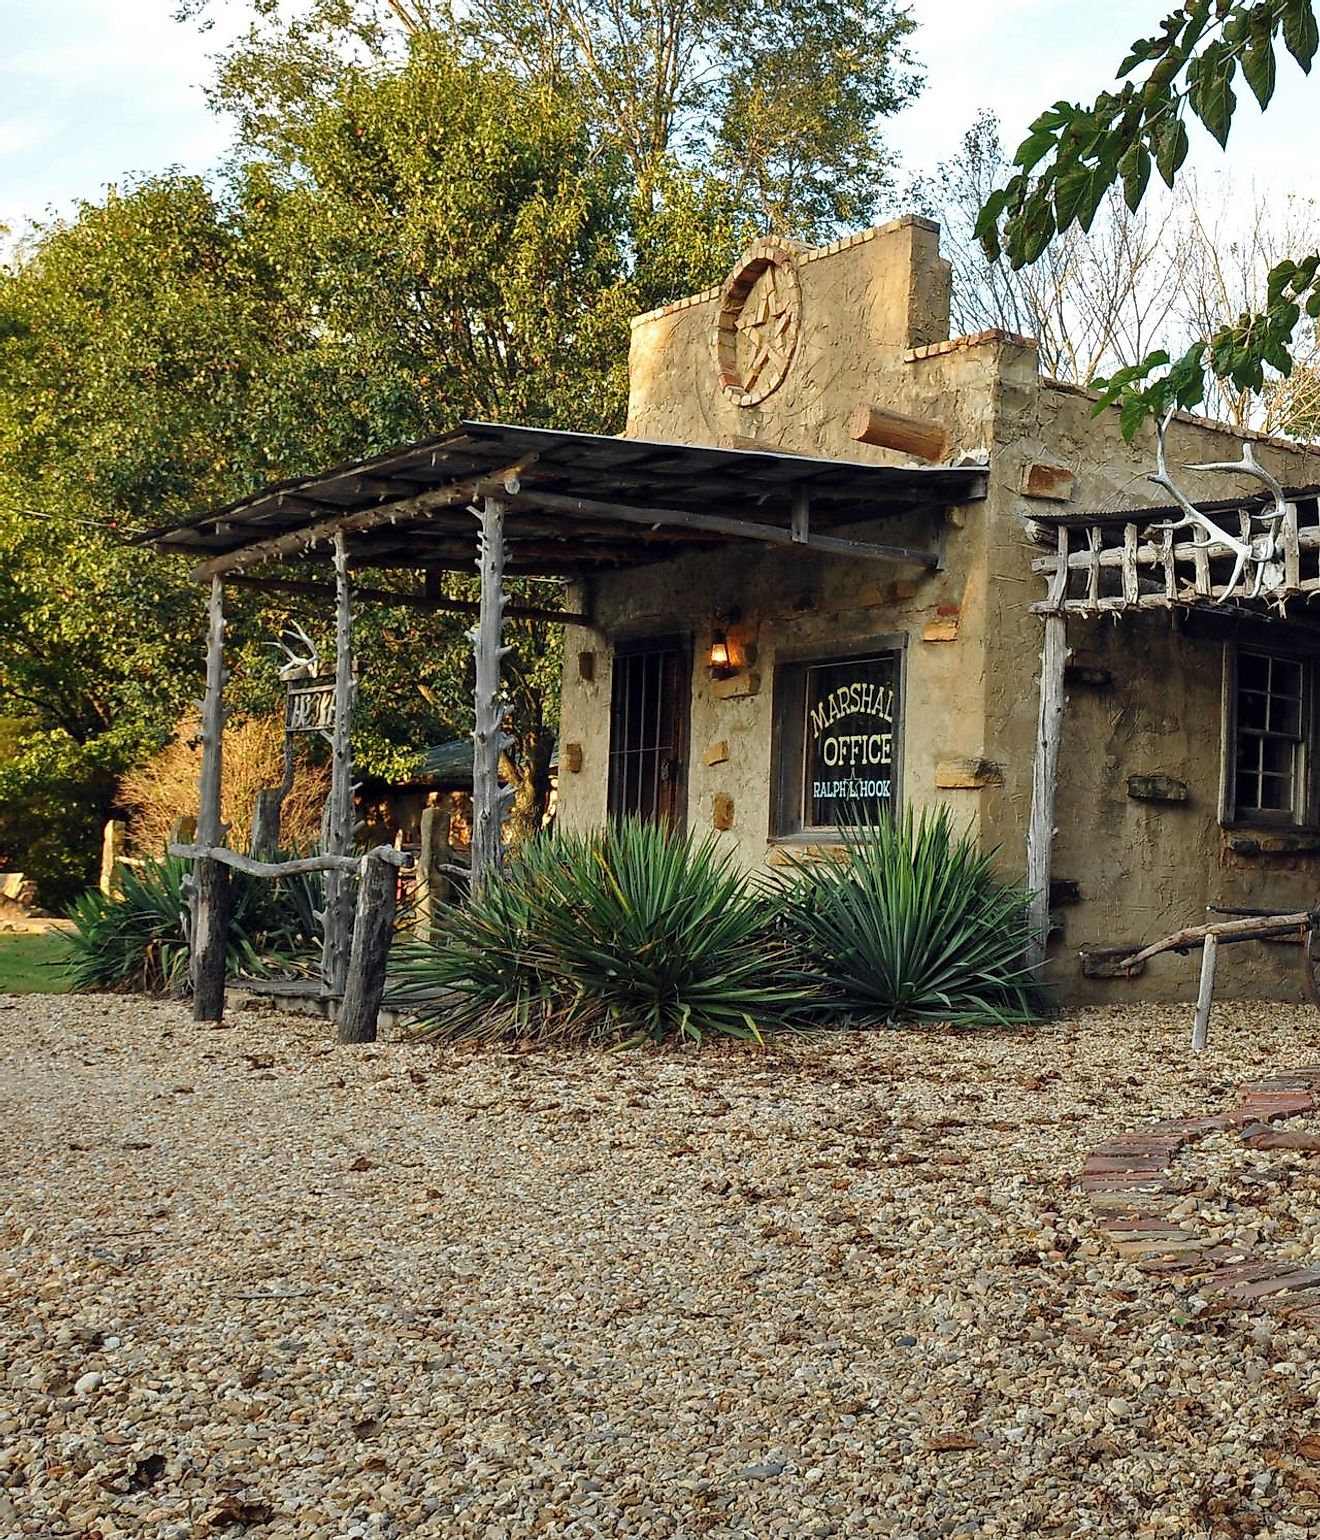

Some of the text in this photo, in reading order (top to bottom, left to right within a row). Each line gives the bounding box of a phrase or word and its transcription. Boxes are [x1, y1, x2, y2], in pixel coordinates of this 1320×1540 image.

[810, 683, 893, 738] MARSHAL
[824, 733, 892, 766] OFFICE
[813, 781, 846, 798] RALPH
[859, 780, 891, 797] HOOK
